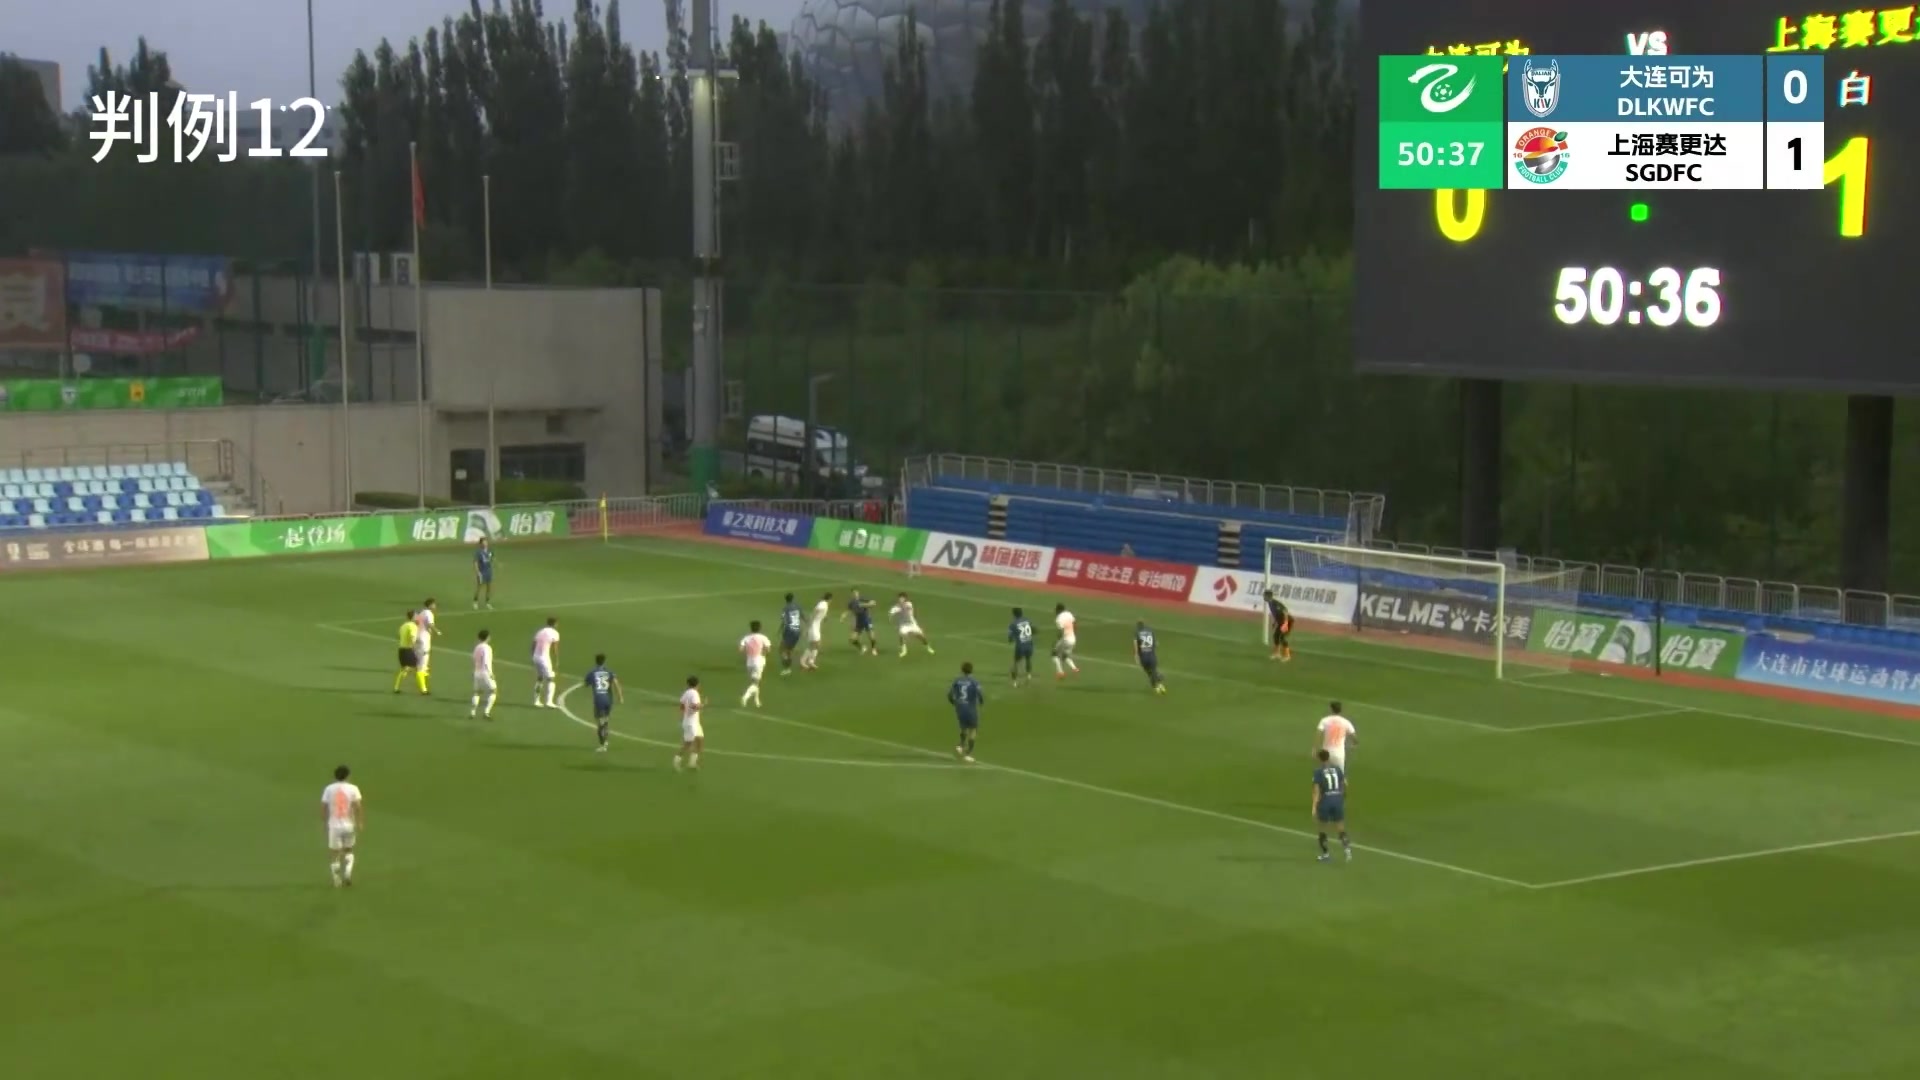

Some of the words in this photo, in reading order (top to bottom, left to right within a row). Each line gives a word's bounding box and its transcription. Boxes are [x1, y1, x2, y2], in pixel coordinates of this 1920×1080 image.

[1626, 32, 1673, 55] VS
[1766, 4, 1920, 52] 上海赛更
[1838, 70, 1871, 107] 白
[1823, 137, 1872, 239] 1
[1553, 266, 1723, 327] 50:36
[1360, 592, 1450, 628] KELME
[1324, 773, 1340, 790] 11
